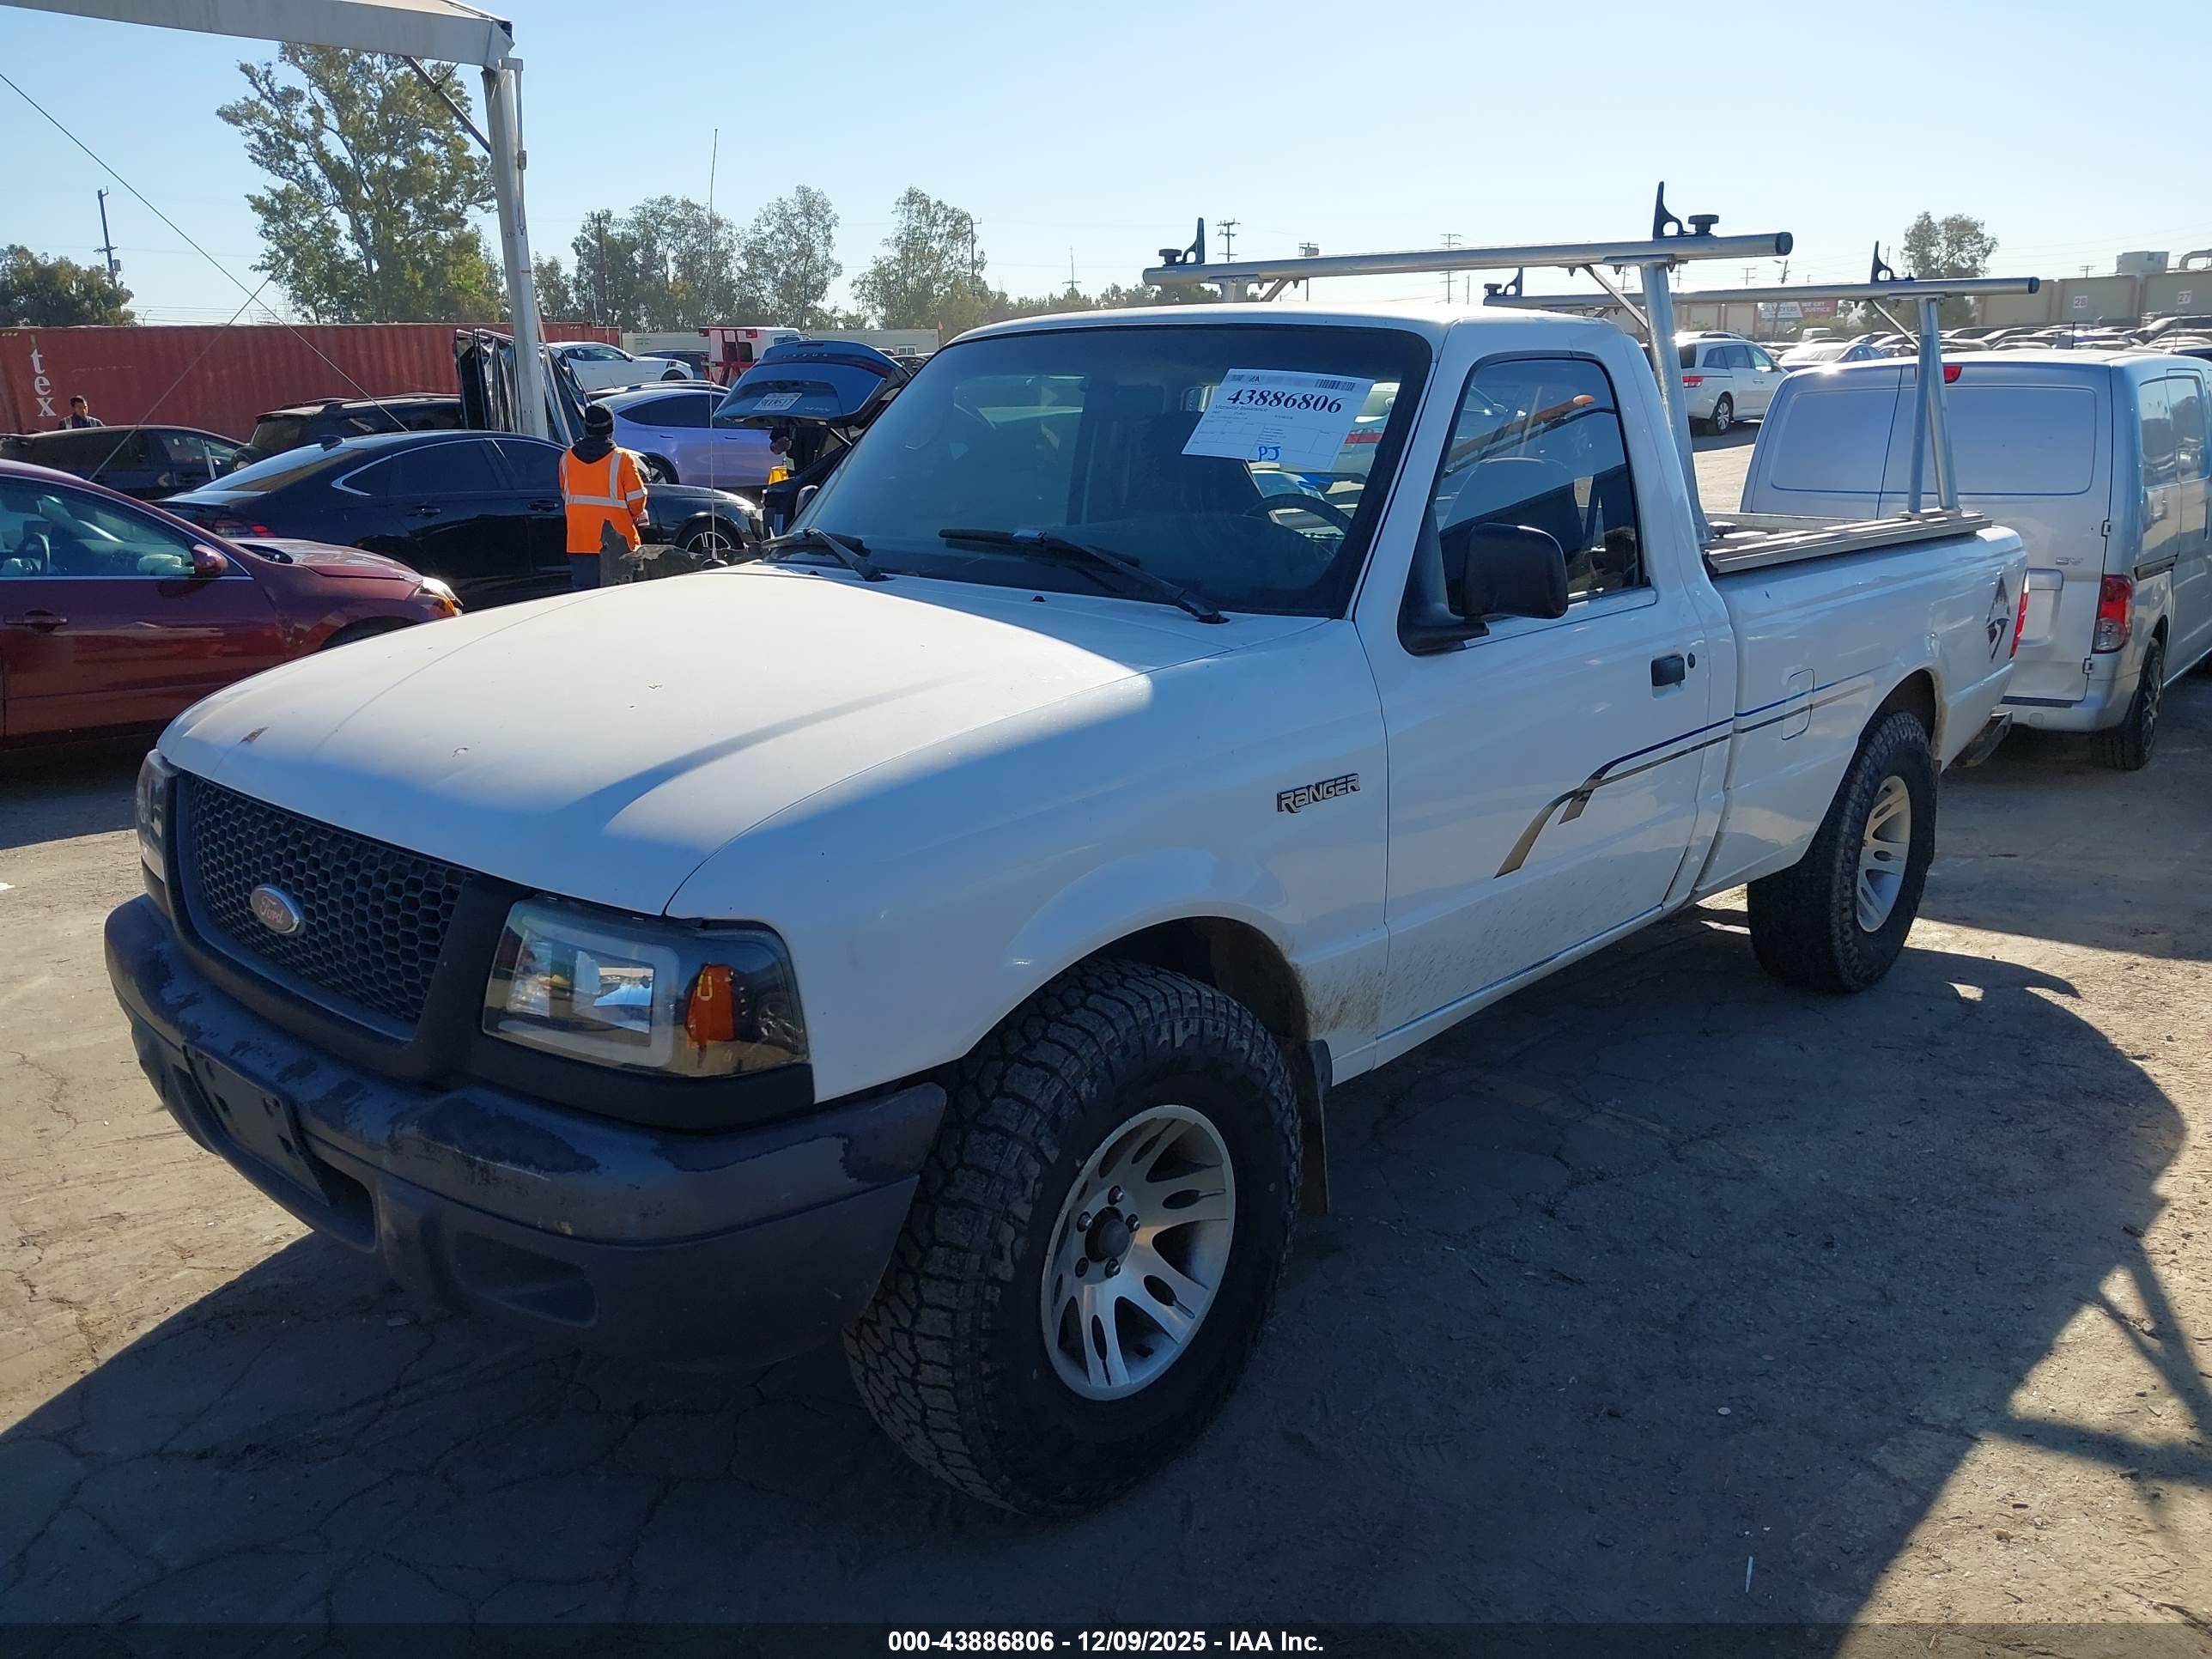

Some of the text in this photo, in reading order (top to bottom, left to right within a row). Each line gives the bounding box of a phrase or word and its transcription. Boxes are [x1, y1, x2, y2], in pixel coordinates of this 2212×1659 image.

[2179, 293, 2190, 302] 27
[31, 349, 57, 416] tex
[1227, 388, 1346, 414] 43886806
